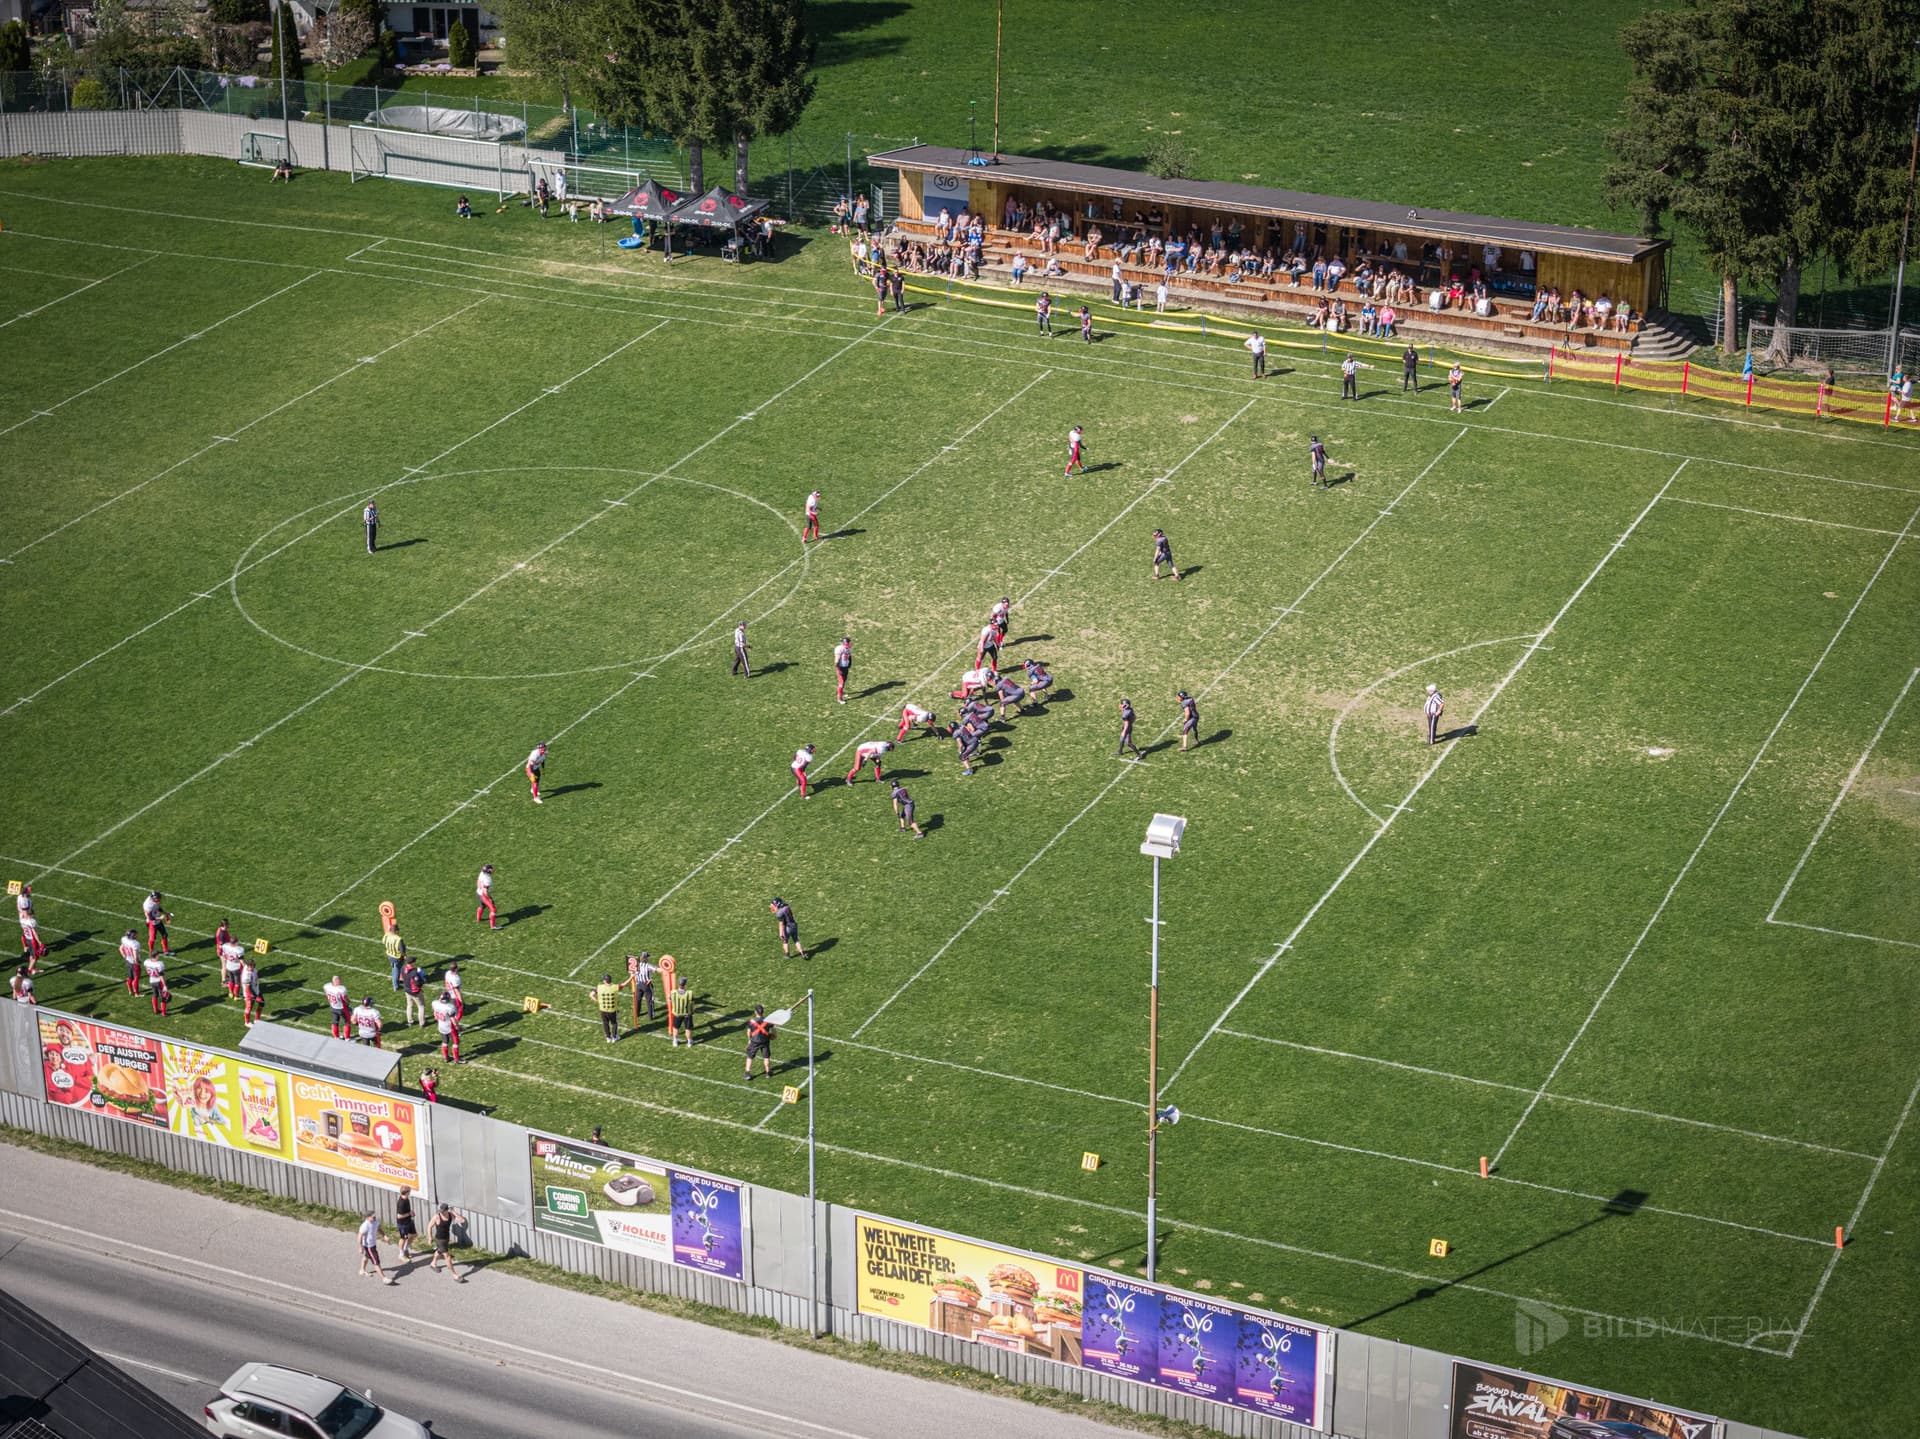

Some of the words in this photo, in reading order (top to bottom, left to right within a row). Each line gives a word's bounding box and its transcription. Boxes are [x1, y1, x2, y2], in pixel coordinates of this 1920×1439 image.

[938, 175, 955, 188] SIG
[98, 1044, 116, 1055] DER
[117, 1047, 156, 1061] AUSTRO-
[113, 1056, 149, 1072] BURGER
[298, 1083, 334, 1101] Geht
[334, 1094, 389, 1117] immer!
[539, 1143, 556, 1153] NEU!
[378, 1163, 415, 1180] Snacks
[545, 1153, 597, 1174] Miimo
[674, 1173, 701, 1184] CIRQUE
[701, 1177, 711, 1186] DU
[712, 1181, 736, 1193] SOLEIL
[552, 1191, 580, 1204] COMING
[557, 1200, 579, 1213] SOON!
[622, 1224, 667, 1242] HOLLEIS
[863, 1226, 937, 1254] WELTWEITE
[864, 1243, 956, 1274] VOLLTREFFER:
[867, 1260, 934, 1286] GELANDET.
[1088, 1274, 1116, 1287] CIRQUE
[1116, 1281, 1129, 1290] DU
[1129, 1285, 1156, 1297] SOLEIL
[1165, 1294, 1194, 1307] CIRQUE
[1194, 1301, 1206, 1309] DU
[1206, 1305, 1233, 1317] SOLEIL
[1243, 1314, 1272, 1327] CIRQUE
[1273, 1321, 1285, 1330] DU
[1285, 1325, 1312, 1337] SOLEIL
[1476, 1383, 1510, 1397] BEYOND
